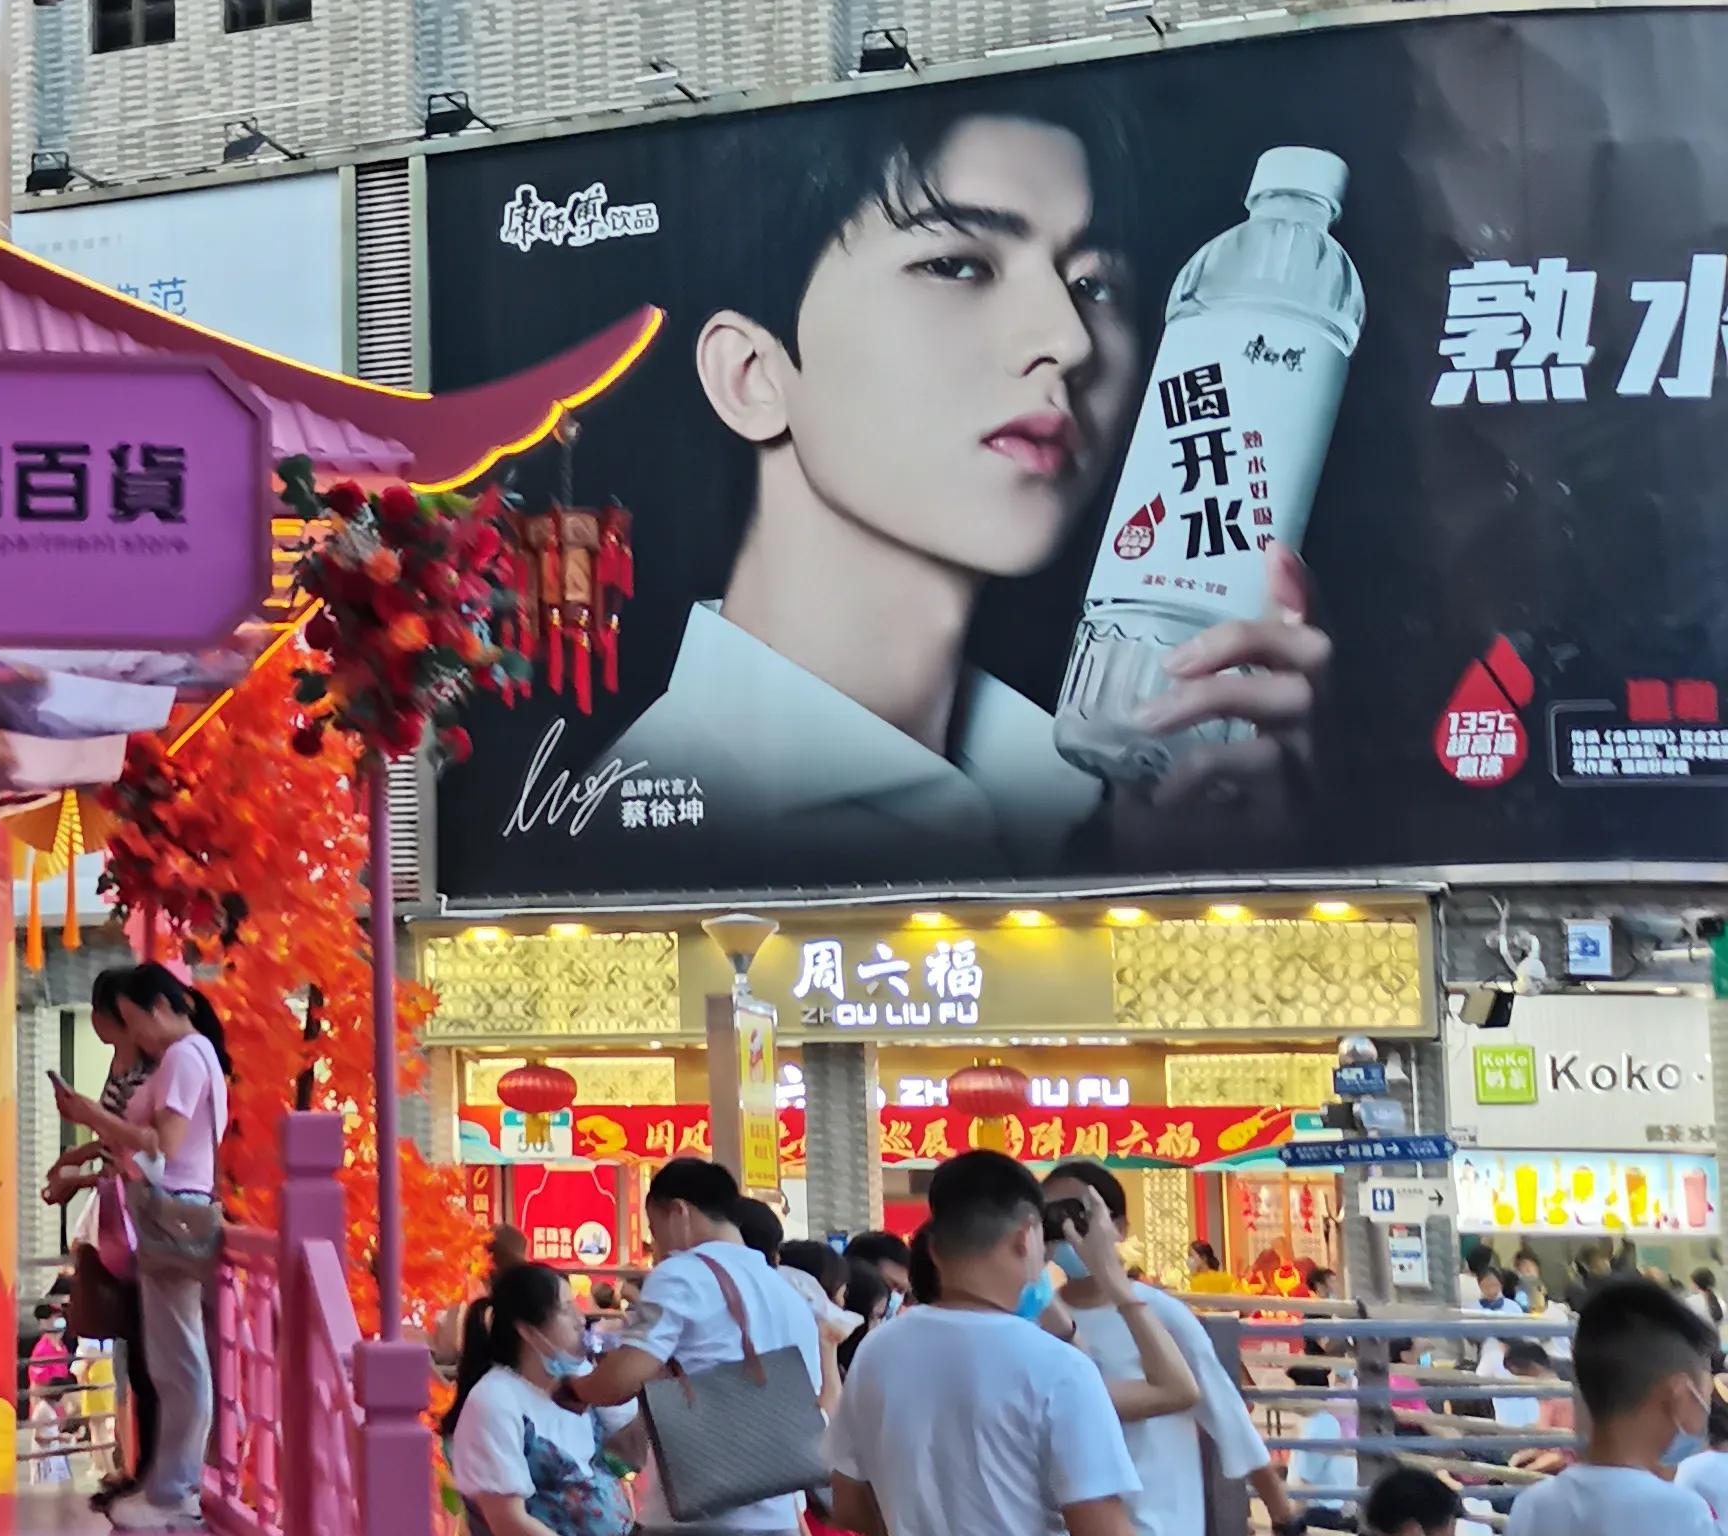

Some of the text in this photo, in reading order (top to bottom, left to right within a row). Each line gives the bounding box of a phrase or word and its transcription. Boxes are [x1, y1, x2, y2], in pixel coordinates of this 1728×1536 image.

[1158, 362, 1251, 561] 喝开水
[620, 777, 705, 798] 品牌代言人
[620, 797, 705, 829] 蔡徐坤
[792, 939, 984, 1001] 周六福
[801, 1000, 979, 1027] ZHOU LIU FU
